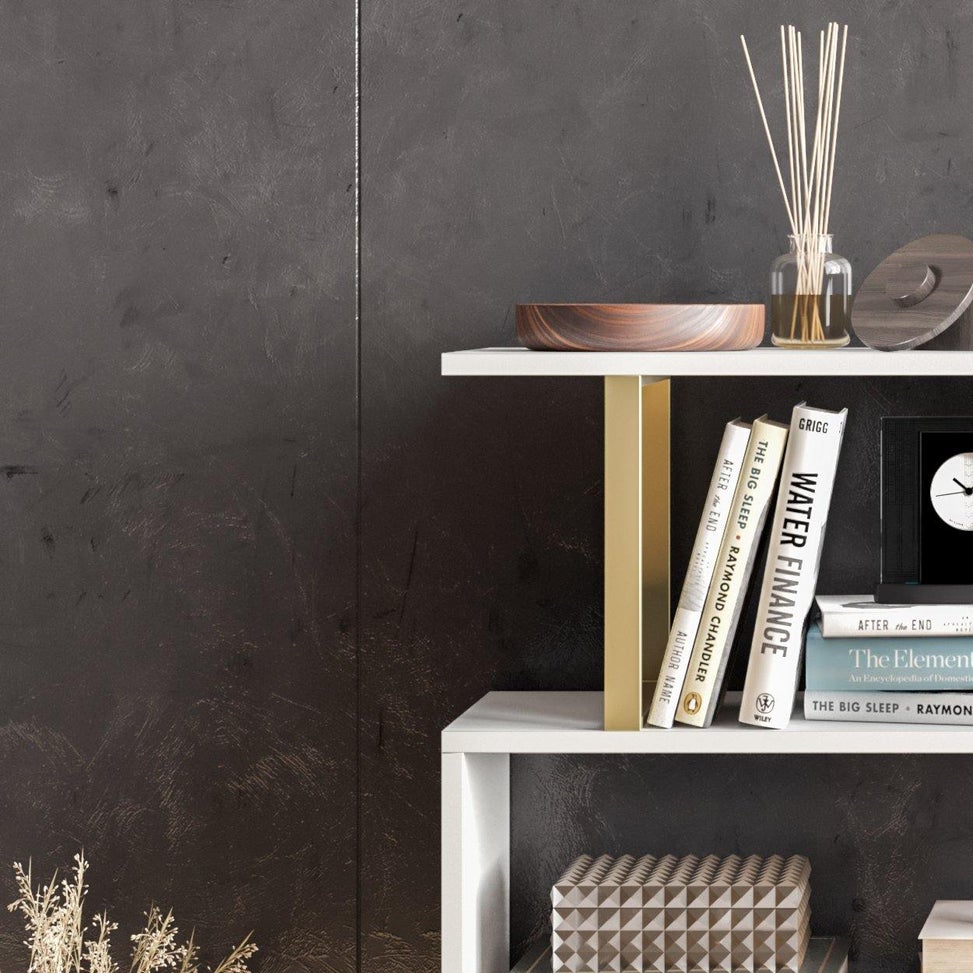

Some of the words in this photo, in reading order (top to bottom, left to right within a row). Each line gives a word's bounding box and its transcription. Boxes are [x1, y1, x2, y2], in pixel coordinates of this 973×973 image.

[799, 418, 829, 434] GRIGG
[754, 441, 769, 463] THE
[717, 458, 734, 491] AFTER
[747, 467, 761, 489] BIG
[706, 511, 721, 532] END
[737, 494, 754, 530] SLEEP
[780, 472, 818, 549] WATER
[715, 546, 740, 611] RAYMOND
[760, 555, 803, 658] FINANCE
[858, 619, 889, 631] AFTER
[895, 622, 908, 631] the
[911, 619, 932, 631] END
[668, 631, 687, 670] AUTHOR
[695, 616, 721, 682] CHANDLER
[848, 648, 890, 668] The
[848, 673, 861, 682] An
[863, 673, 923, 683] Encyclopedia
[924, 673, 933, 682] of
[659, 676, 674, 704] NAME
[753, 714, 772, 723] WILEY
[812, 701, 836, 712] THE
[839, 701, 861, 713] BIG
[866, 702, 900, 714] SLEEP
